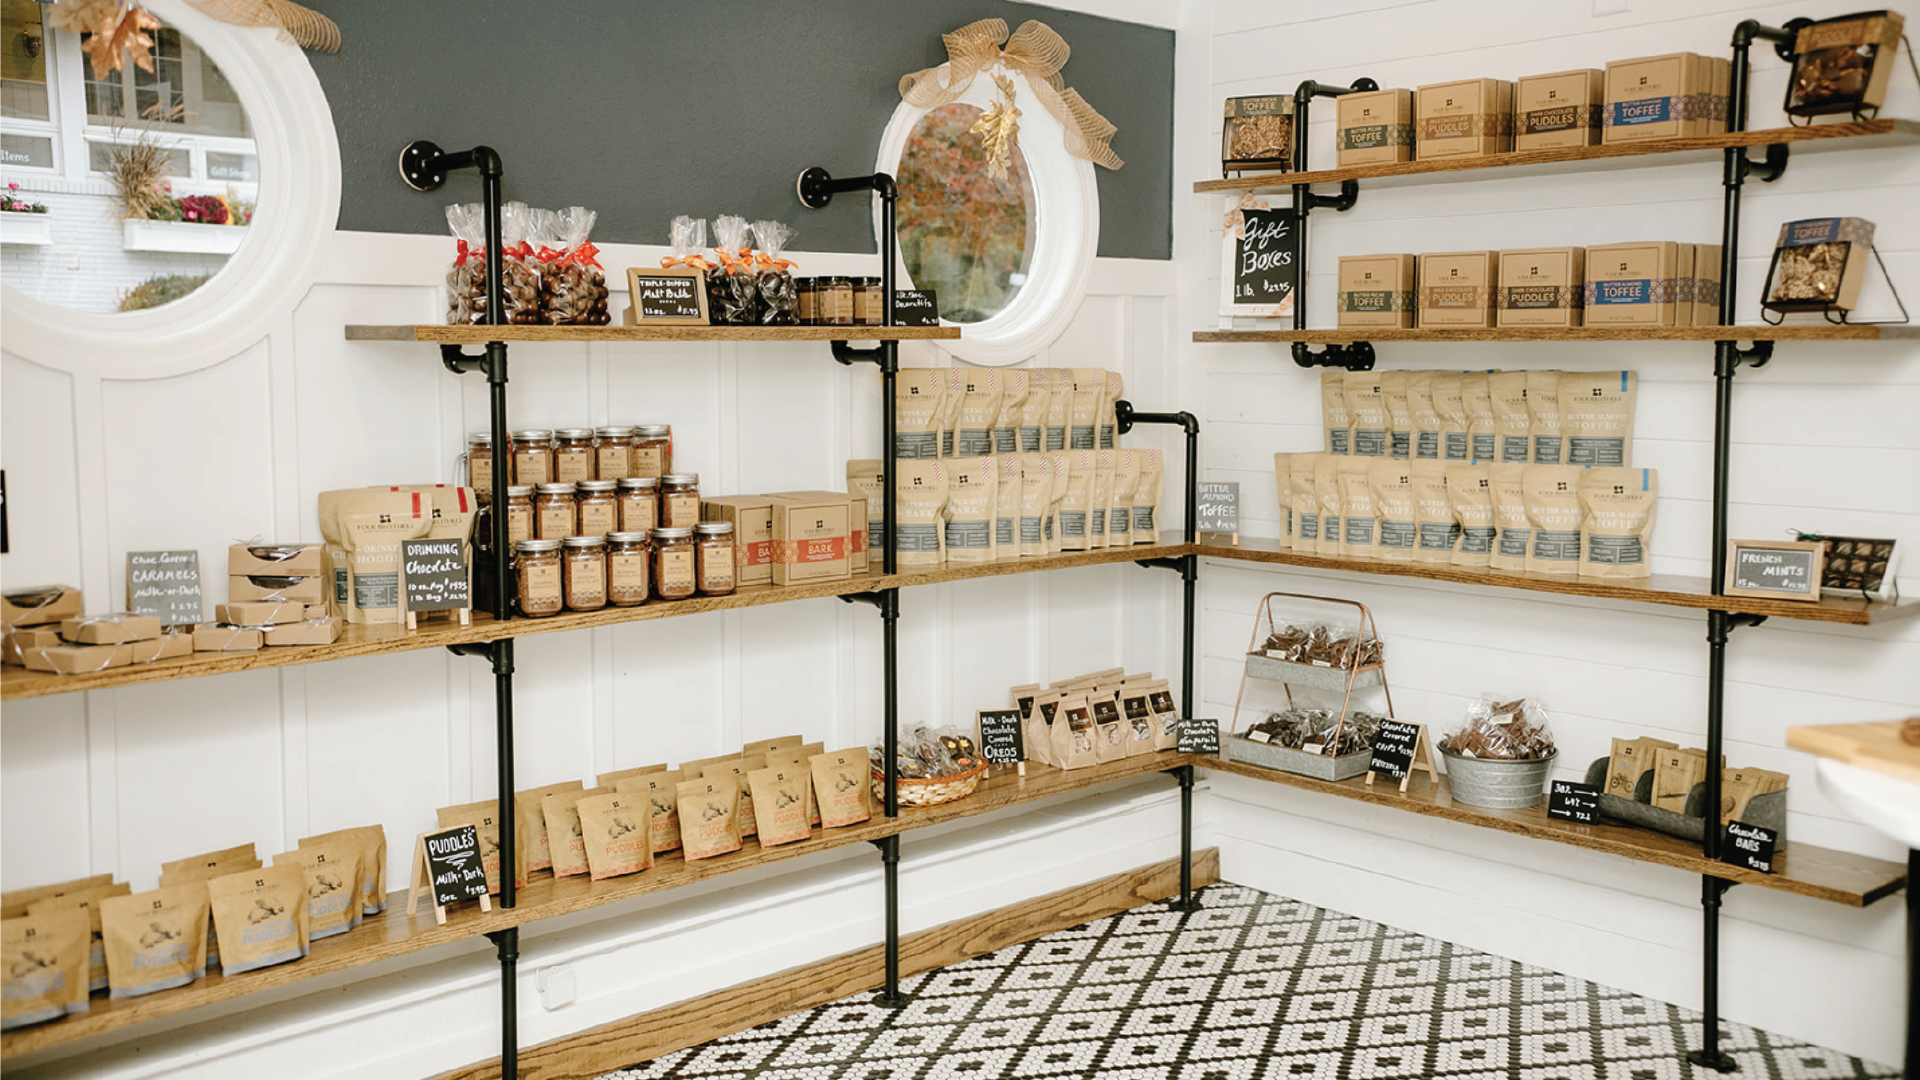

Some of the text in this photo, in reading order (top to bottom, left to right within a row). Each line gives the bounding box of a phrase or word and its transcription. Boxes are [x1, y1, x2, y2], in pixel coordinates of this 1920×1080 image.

[1242, 102, 1277, 111] TOFFEE
[1622, 104, 1662, 117] TOFFEE
[1530, 113, 1575, 127] PUDDLES
[1428, 121, 1470, 133] PUDDLES
[1350, 132, 1383, 143] TOFFEE
[1243, 217, 1290, 252] Gift
[1794, 226, 1831, 239] TOFFEE
[1240, 250, 1292, 277] Boxes
[642, 288, 693, 299] Malt Balls
[1432, 293, 1474, 302] PUDDLES
[1511, 292, 1555, 303] PUDDLES
[1604, 286, 1643, 298] TOFFEE
[1353, 297, 1385, 307] TOFFEE
[1566, 413, 1596, 421] BUTTER
[1575, 420, 1620, 430] TOFFEE
[1198, 483, 1230, 493] BUTTER
[1202, 493, 1235, 502] ALMOND
[905, 509, 935, 518] BARK
[407, 543, 459, 556] DRINKING
[758, 548, 770, 557] BA
[808, 544, 834, 555] BARK
[1741, 553, 1782, 564] FRENCH
[406, 559, 462, 574] Chocolate
[1762, 566, 1804, 577] MINTS
[132, 569, 199, 582] CARAMELS
[983, 724, 1017, 735] Chocolate
[1381, 721, 1416, 734] Chocolate
[1382, 730, 1411, 742] Covered
[983, 745, 1017, 759] OREOS
[1728, 823, 1773, 842] Chocolate
[428, 832, 475, 856] PUDDLES
[605, 840, 645, 856] PUDDLES
[1735, 837, 1760, 852] BARS
[435, 866, 485, 885] Milk Dark
[242, 924, 297, 945] PUDDLES
